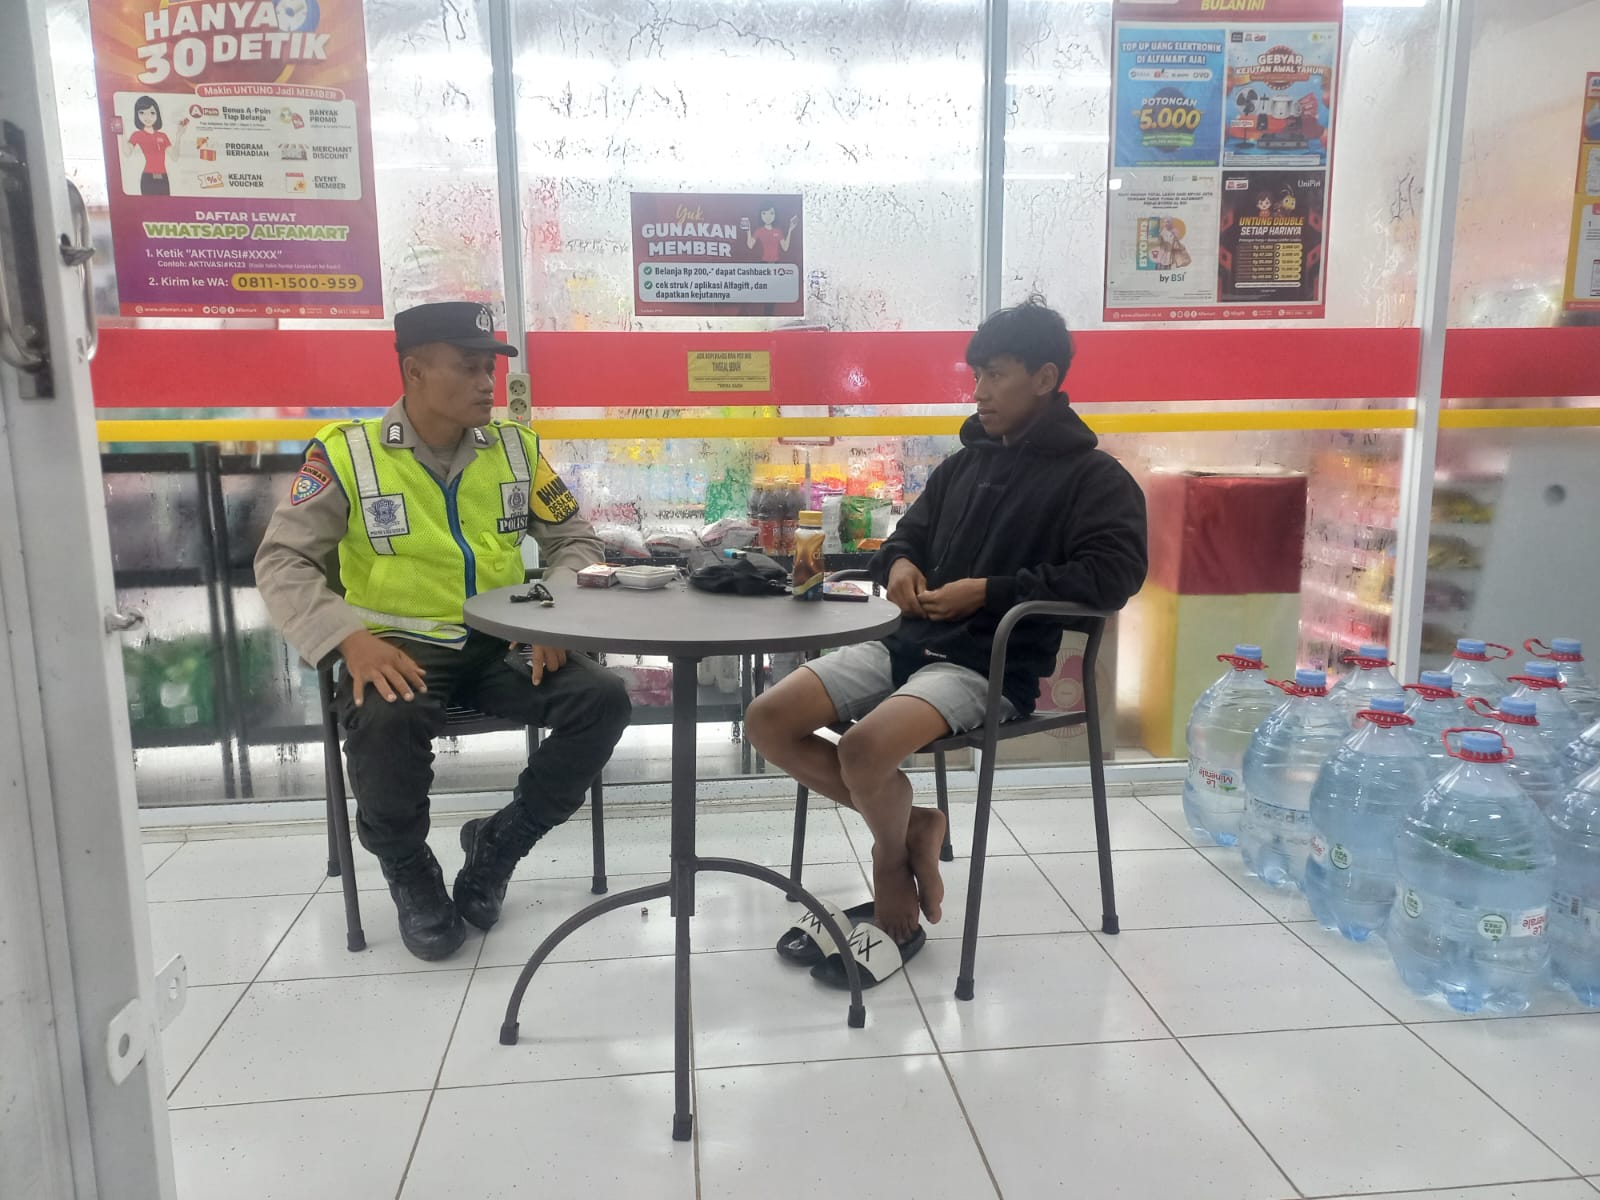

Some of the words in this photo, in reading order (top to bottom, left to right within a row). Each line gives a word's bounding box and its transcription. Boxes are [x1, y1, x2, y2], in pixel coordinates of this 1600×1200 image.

[1200, 0, 1244, 10] BULAN
[1246, 0, 1266, 10] INI
[143, 1, 278, 41] HANYA
[1138, 42, 1150, 50] UP
[138, 37, 207, 84] 30
[212, 33, 332, 62] DETIK
[1147, 55, 1188, 64] ALFAMART
[1258, 54, 1303, 65] GEBYAR
[1272, 65, 1296, 74] AWAL
[1296, 66, 1324, 75] TAHUN
[204, 86, 232, 96] Makin
[233, 86, 273, 96] UNTUNG
[274, 87, 294, 97] Jadi
[296, 89, 337, 99] MEMBER
[1142, 96, 1198, 107] POTONGAN
[240, 114, 267, 122] Belanja
[1140, 108, 1201, 130] 5.000
[225, 143, 263, 151] PROGRAM
[311, 145, 352, 153] MERCHANT
[226, 150, 270, 158] BERHADIAH
[311, 152, 349, 160] DISCOUNT
[229, 180, 264, 188] VOUCHER
[195, 211, 249, 222] DAFTAR
[251, 212, 297, 222] LEWAT
[1239, 217, 1272, 226] UNTUNG
[1273, 217, 1305, 226] DOUBLE
[144, 222, 250, 239] WHATSAPP
[251, 225, 349, 241] ALFAMART
[641, 223, 737, 240] GUNAKAN
[1240, 226, 1268, 236] SETIAP
[1269, 226, 1302, 236] HARINYA
[145, 249, 154, 257] 1.
[156, 248, 184, 258] Ketik
[186, 249, 283, 259] "AKTIVASI#XXXX"
[648, 240, 732, 258] MEMBER
[157, 260, 187, 268] Contoh:
[655, 267, 682, 277] Belanja
[683, 267, 693, 277] Rp
[715, 267, 736, 277] dapat
[736, 267, 771, 276] Cashback
[148, 277, 159, 286] 2.
[161, 277, 189, 286] Kirim
[191, 277, 205, 286] ke
[206, 277, 229, 287] WA:
[237, 277, 357, 289] 0811-1500-959
[1159, 273, 1170, 283] by
[655, 281, 670, 289] cek
[670, 281, 689, 289] struk
[694, 281, 722, 291] aplikasi
[754, 281, 768, 290] dan
[655, 291, 690, 299] dapatkan
[690, 291, 730, 300] kejutannya
[1199, 768, 1233, 784] Minerale
[1206, 778, 1216, 788] Le
[1532, 925, 1542, 936] Le
